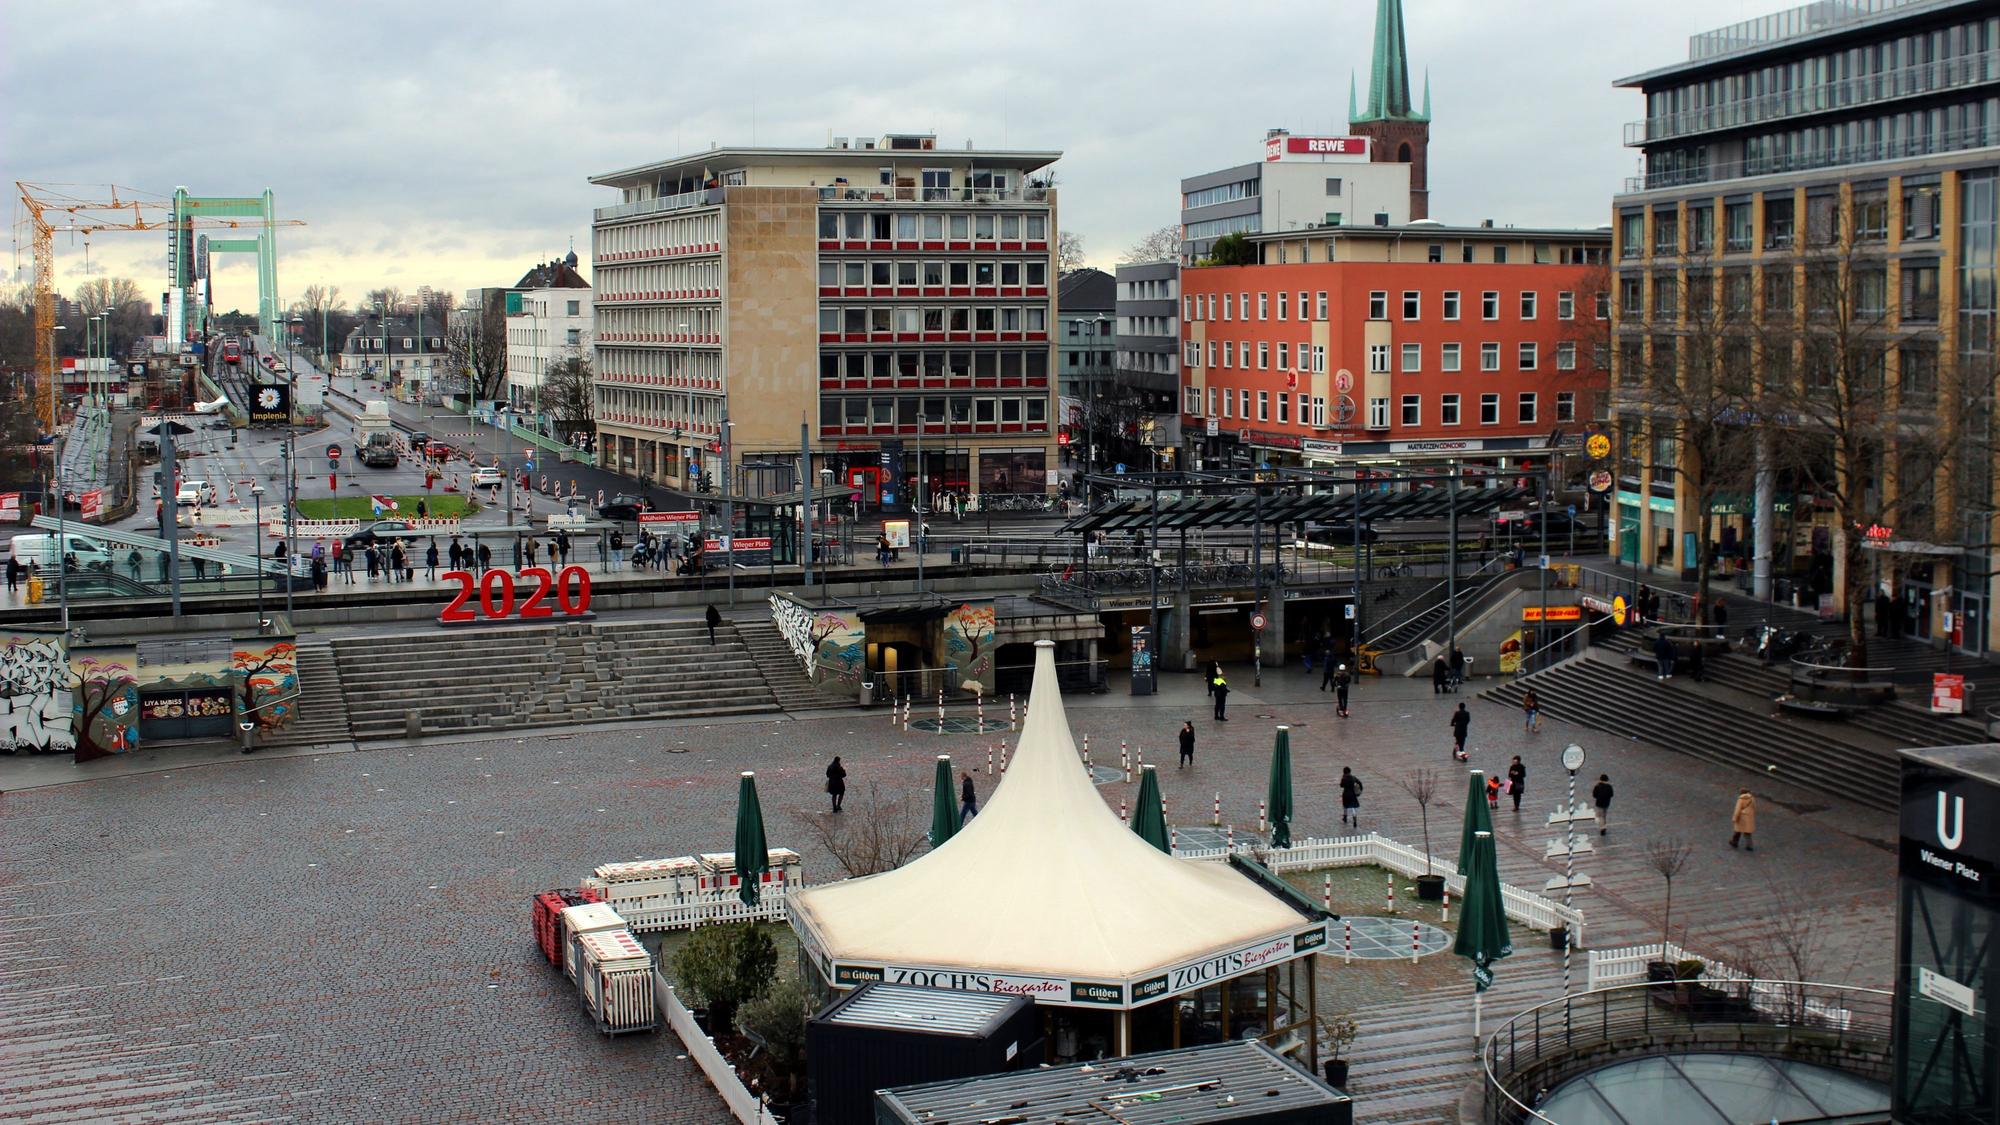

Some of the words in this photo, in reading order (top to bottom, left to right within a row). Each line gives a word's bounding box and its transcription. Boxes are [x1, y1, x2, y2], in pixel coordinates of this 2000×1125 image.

[1267, 142, 1280, 157] REWE
[1308, 139, 1345, 152] REWE
[252, 412, 287, 420] Implenia
[755, 540, 769, 548] Platz
[441, 566, 592, 621] 2020
[1162, 596, 1169, 604] U
[1936, 790, 1964, 851] U
[1920, 848, 1954, 872] Wiener
[1955, 861, 1980, 881] Platz
[1174, 953, 1243, 990] ZOCH'S
[1243, 940, 1290, 968] Biergarten
[851, 969, 881, 981] Gilden
[993, 979, 1064, 996] Biergarten
[1088, 986, 1119, 999] Gilden
[1143, 980, 1166, 994] Gilden
